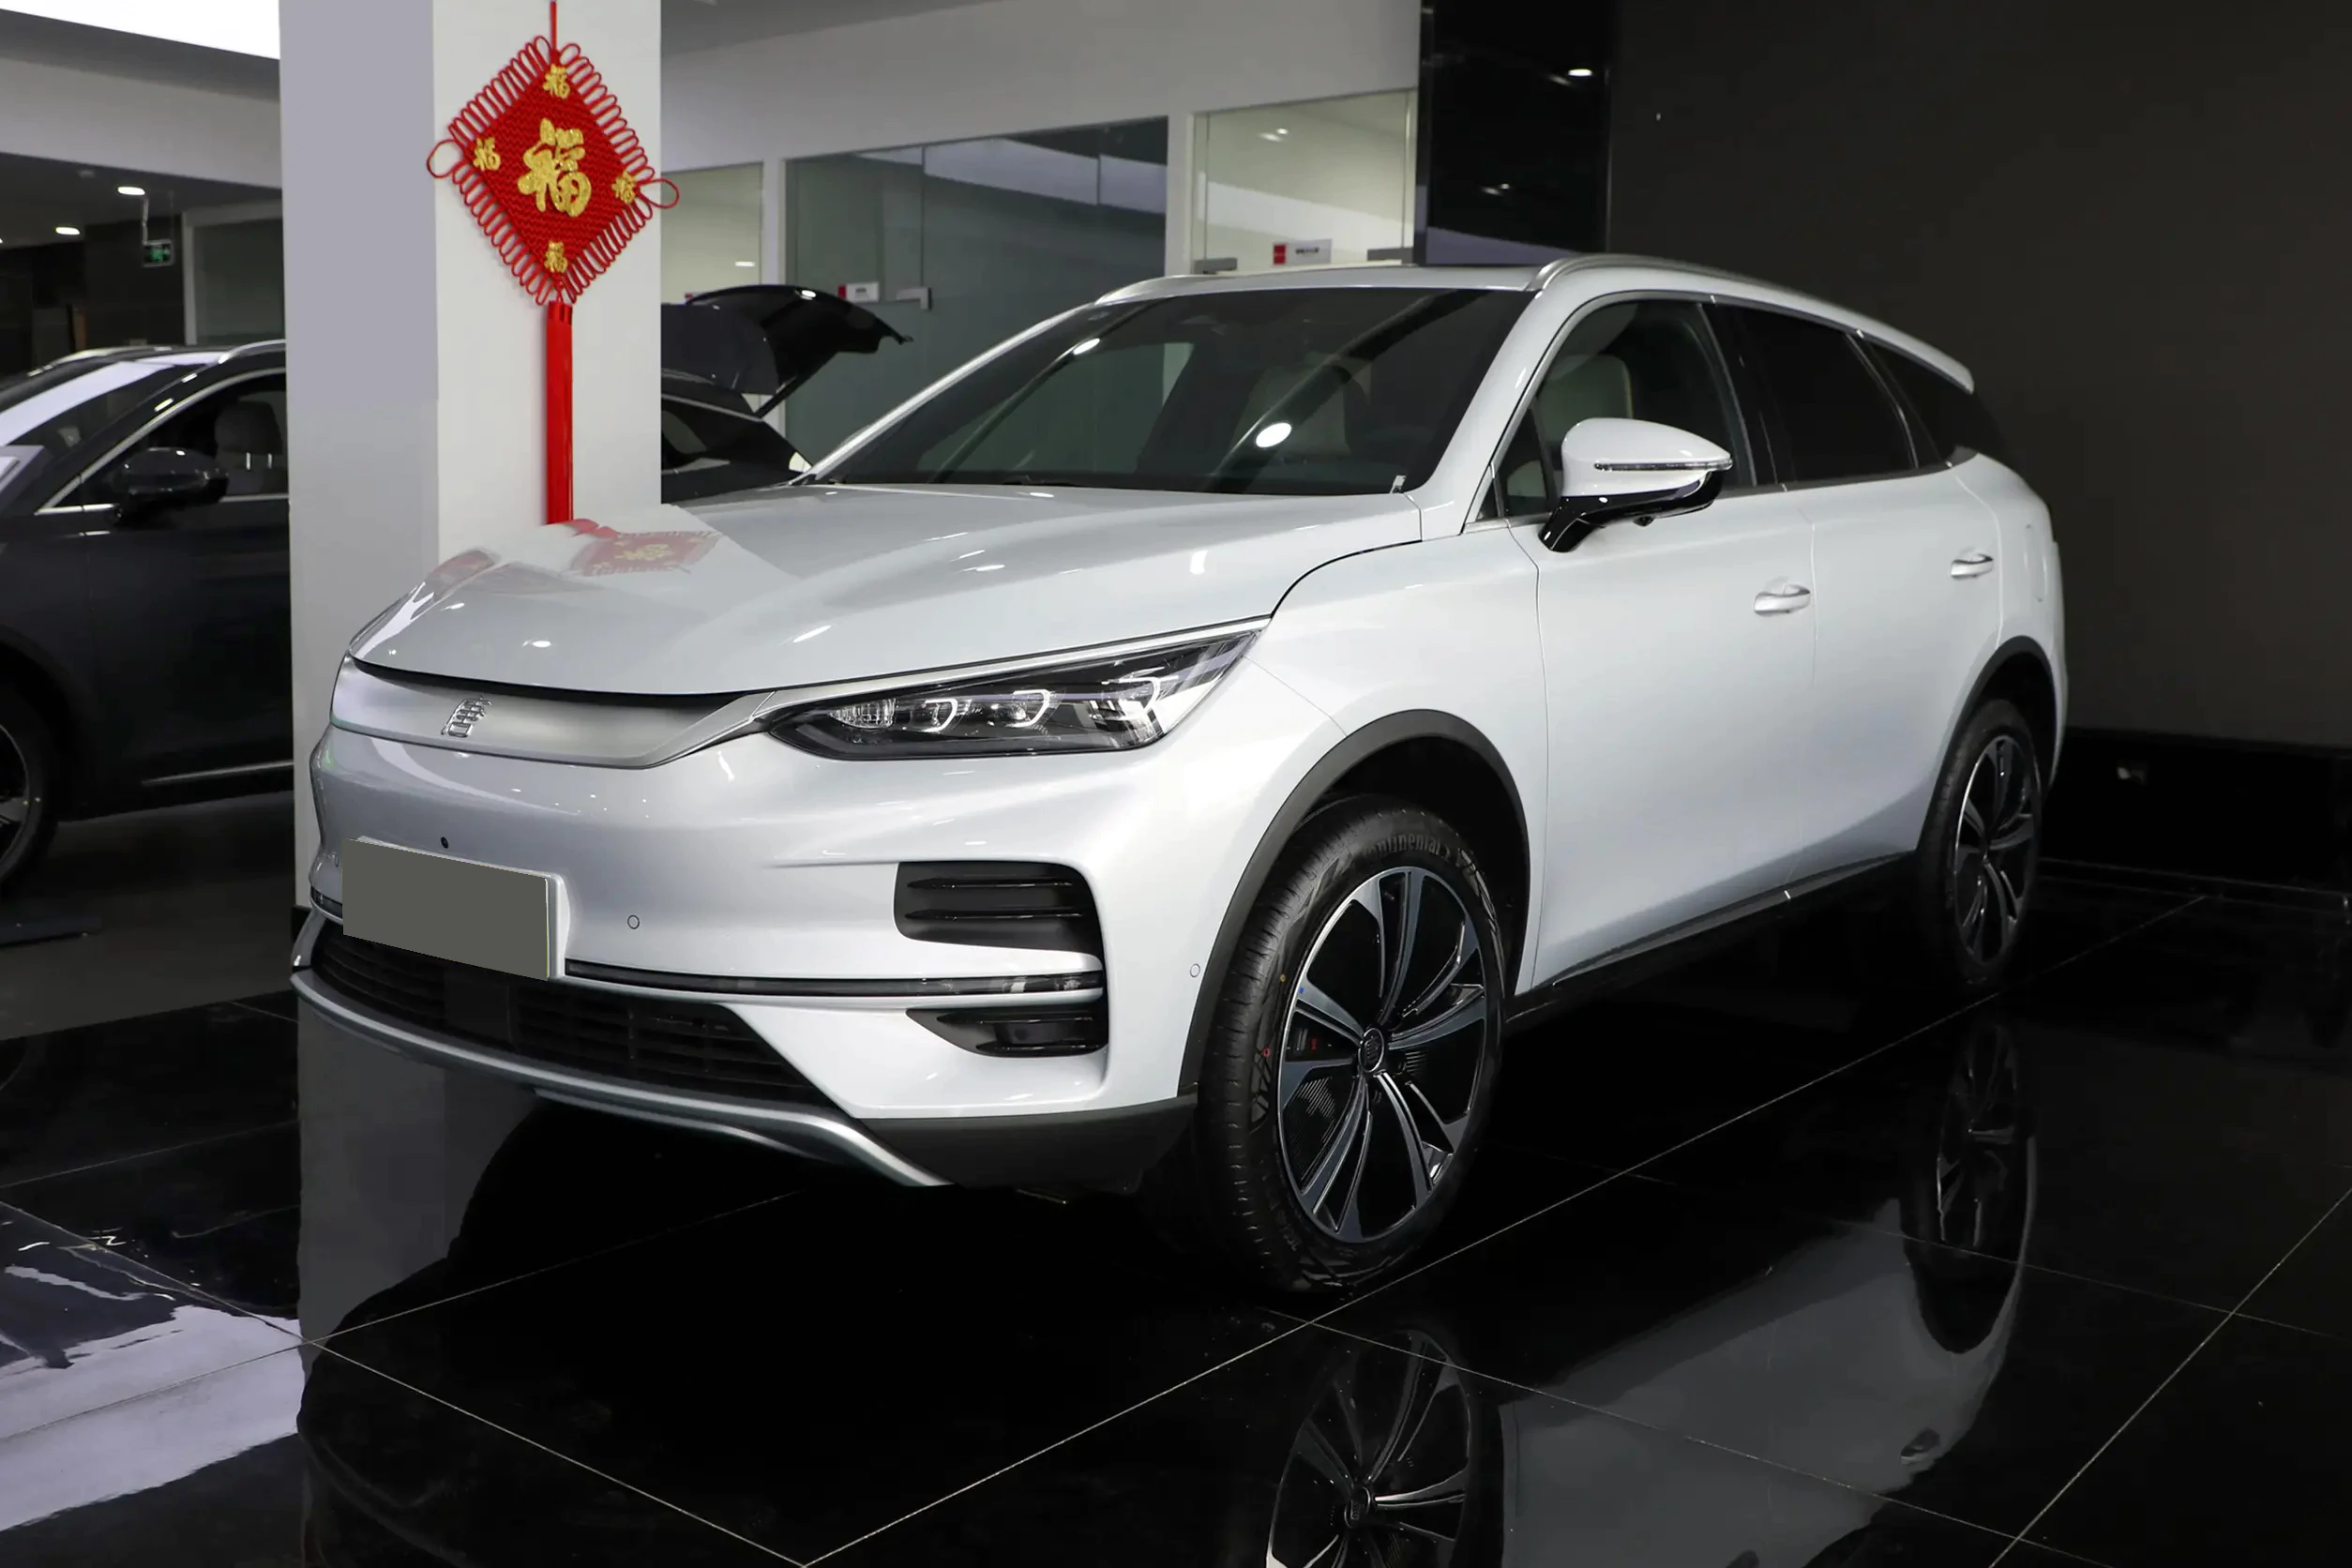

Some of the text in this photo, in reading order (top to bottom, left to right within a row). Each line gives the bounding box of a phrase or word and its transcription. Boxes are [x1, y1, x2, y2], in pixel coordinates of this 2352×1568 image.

[542, 63, 570, 98] 福
[473, 137, 501, 172] 福
[518, 118, 592, 218] 福
[1362, 833, 1441, 858] ntinental
